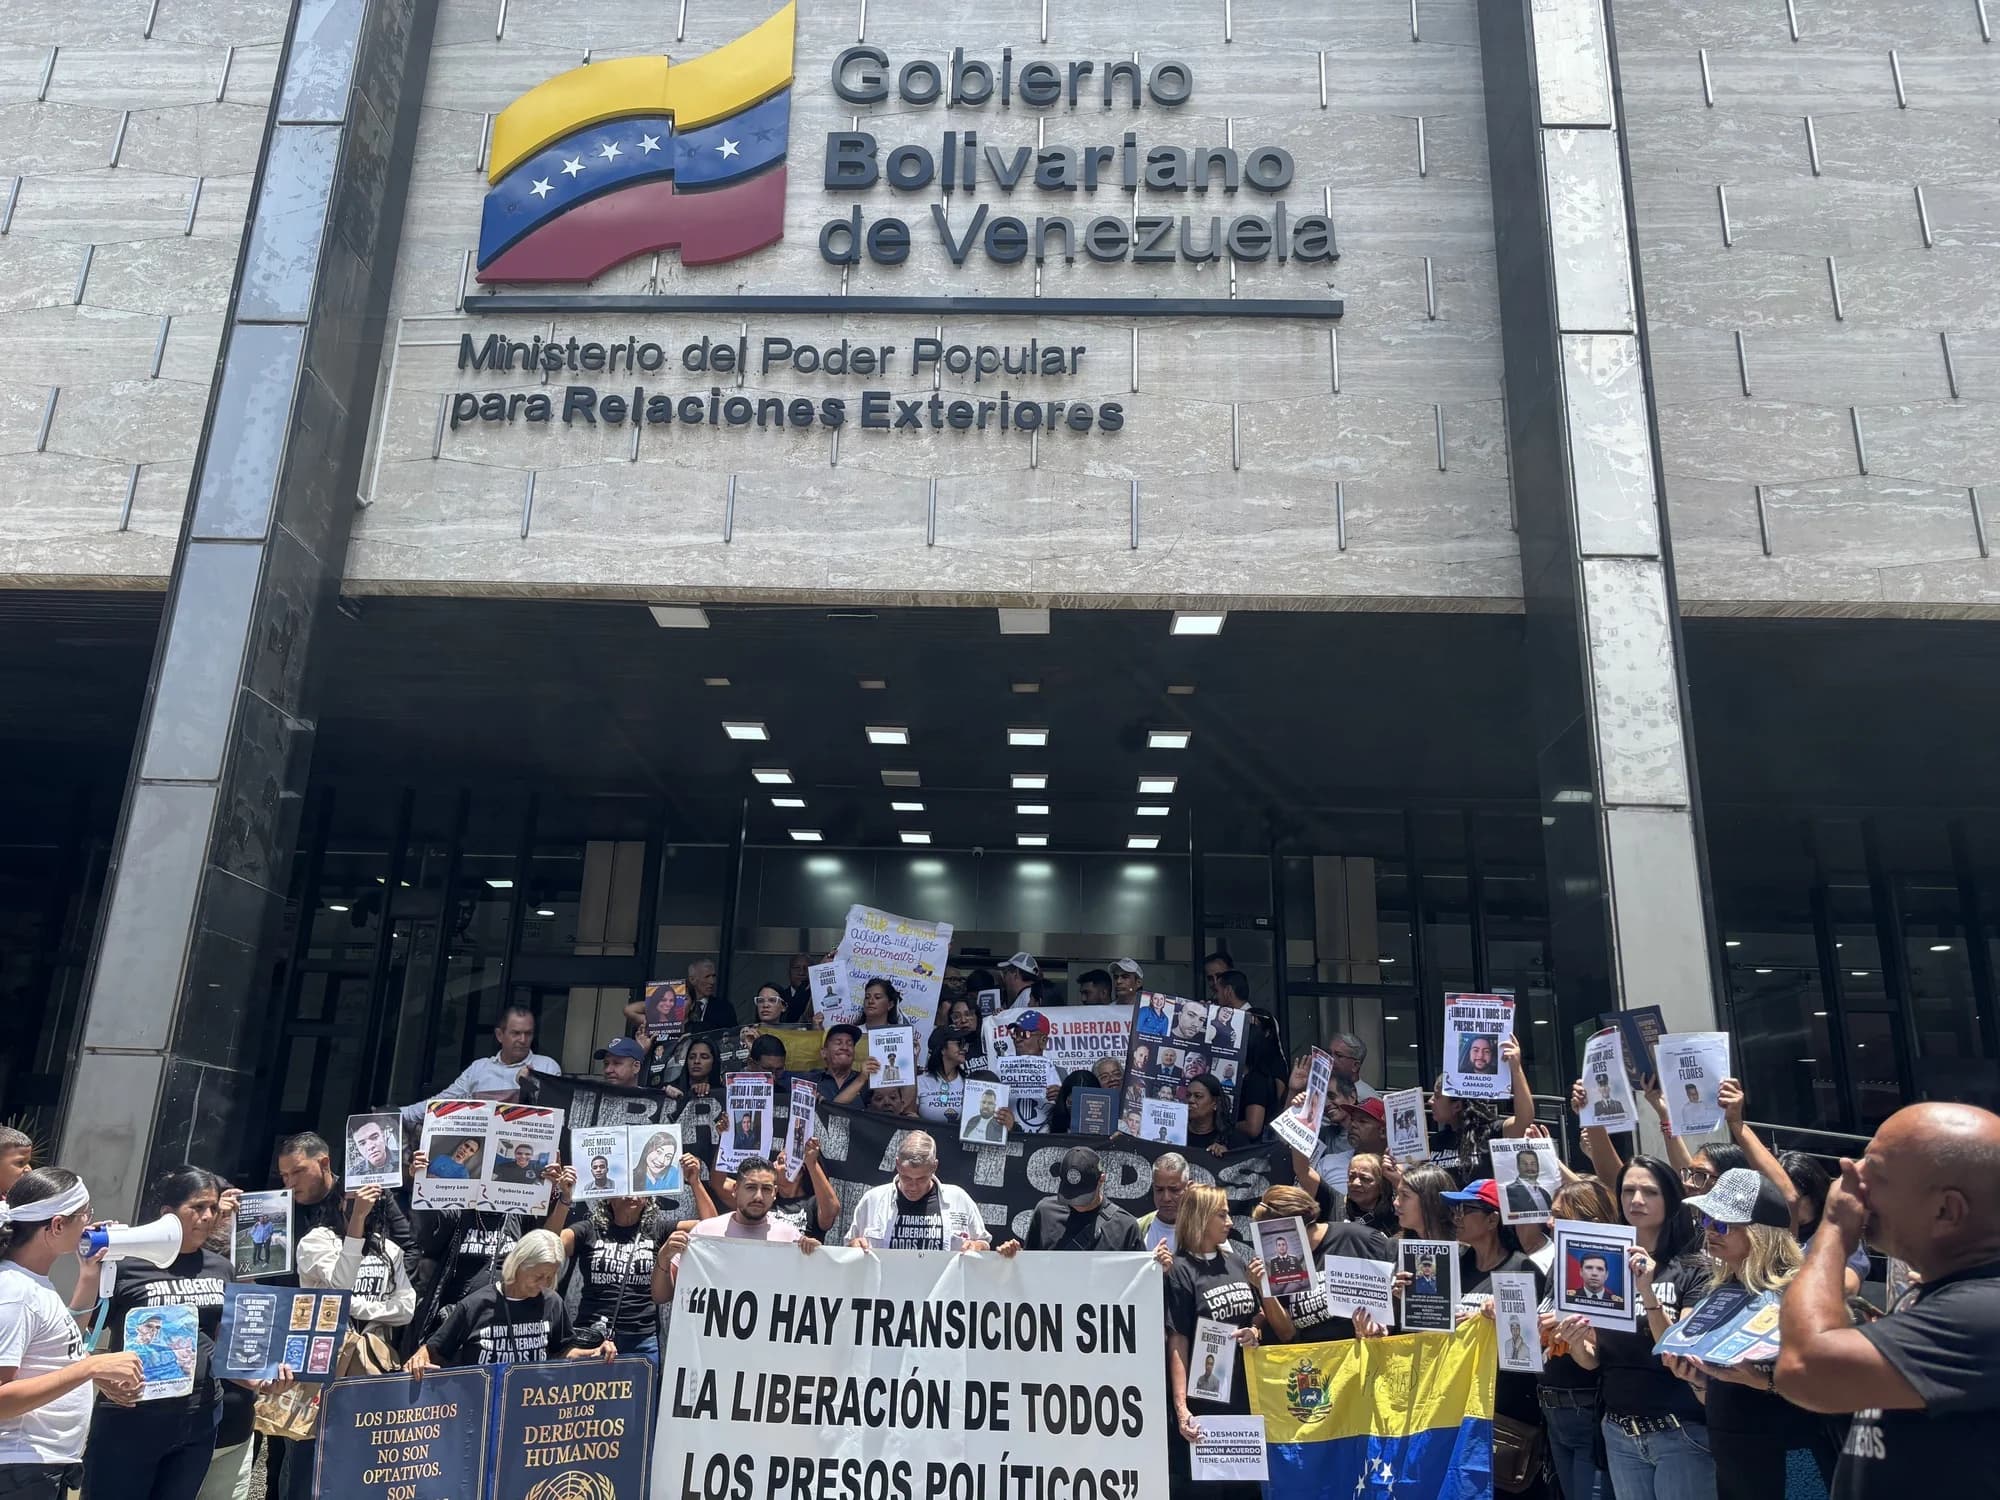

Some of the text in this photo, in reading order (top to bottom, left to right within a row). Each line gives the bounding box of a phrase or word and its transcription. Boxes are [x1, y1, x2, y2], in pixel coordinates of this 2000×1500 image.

[832, 45, 1193, 107] Gobierno
[824, 130, 1295, 193] Bolivariano
[819, 201, 1339, 267] de Venezuela
[457, 333, 1085, 384] Ministerio del Poder Popular
[450, 385, 1124, 431] para Relaciones Exteriores
[1062, 1022, 1122, 1036] LIBERTAD
[1679, 1056, 1698, 1068] NOEL
[1678, 1068, 1704, 1080] FLORES
[596, 1138, 616, 1147] MIGUEL
[1492, 1143, 1512, 1152] DANIEL
[587, 1146, 612, 1156] ESTRADA
[902, 1213, 943, 1226] TRANSICIÓN
[897, 1226, 941, 1238] LIBERACIÓN
[891, 1240, 920, 1250] ODOS
[1404, 1244, 1449, 1256] LIBERTAD
[1344, 1272, 1386, 1283] DESMONTAR
[145, 1281, 170, 1296] SIN
[1358, 1290, 1387, 1299] ACUERDO
[1207, 1295, 1227, 1310] LOS
[1332, 1296, 1386, 1308] TIENE GARANTÍAS
[688, 1288, 1136, 1355] “NO HAY TRANSICION SIN
[480, 1326, 491, 1338] NO
[492, 1325, 508, 1338] HAY
[496, 1338, 506, 1351] LA
[478, 1349, 492, 1364] DE
[521, 1380, 633, 1407] PASAPORTE
[672, 1367, 1144, 1438] LA LIBERACIÓN DE TODOS
[354, 1403, 458, 1428] LOS DERECHOS
[558, 1404, 595, 1420] DE LOS
[371, 1424, 440, 1446] HUMANOS
[522, 1418, 625, 1445] DERECHOS
[376, 1444, 430, 1464] NO SON
[524, 1441, 620, 1468] HUMANOS
[362, 1462, 442, 1485] OPTATIVOS.
[681, 1452, 754, 1500] LOS
[767, 1455, 912, 1500] PRESOS
[387, 1484, 416, 1500] SON
